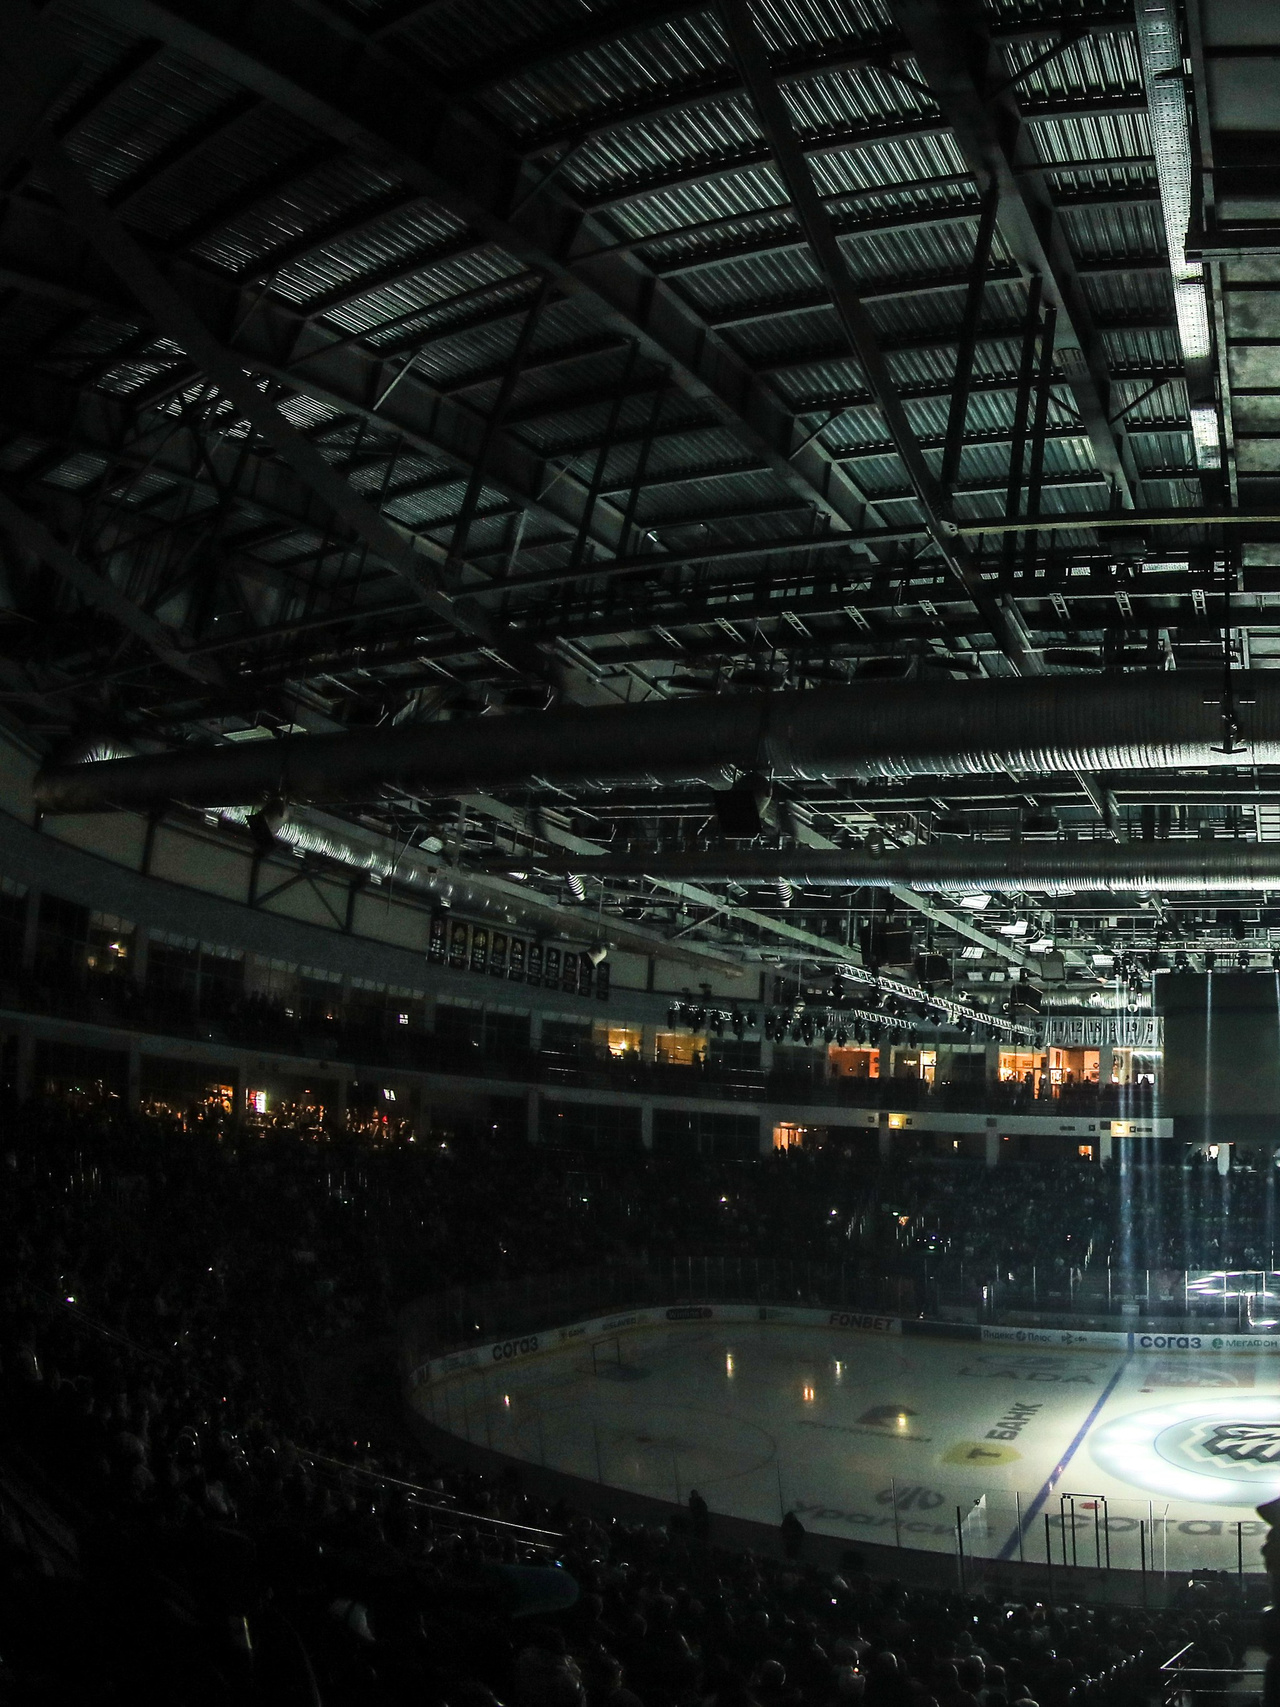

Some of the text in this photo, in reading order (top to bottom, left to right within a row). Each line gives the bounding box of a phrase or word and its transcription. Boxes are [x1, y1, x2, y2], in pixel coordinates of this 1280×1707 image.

[1071, 1021, 1083, 1032] 12
[1089, 1021, 1101, 1032] 18
[1126, 1021, 1138, 1032] 19
[828, 1312, 895, 1331] FONBET
[983, 1329, 1014, 1341] Яндекс
[1140, 1335, 1202, 1349] согаз
[985, 1402, 1043, 1441] БАНК
